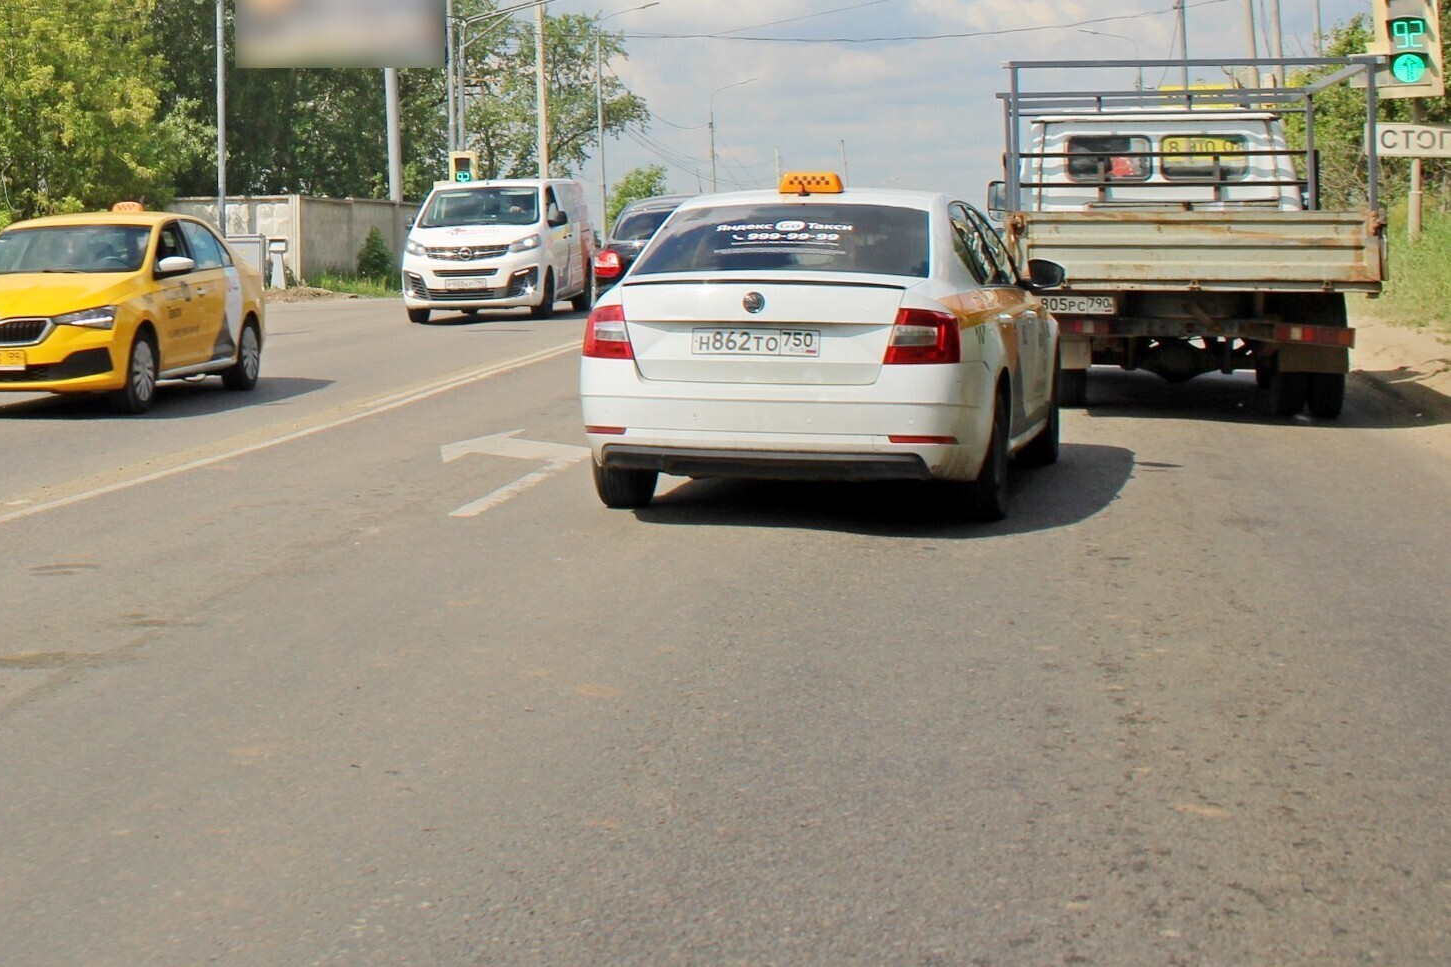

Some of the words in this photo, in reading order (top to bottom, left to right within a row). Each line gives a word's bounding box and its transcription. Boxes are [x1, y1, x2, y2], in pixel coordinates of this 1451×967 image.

[1392, 20, 1424, 48] 92
[716, 223, 774, 232] Яндекс
[807, 223, 853, 231] Такси
[747, 233, 840, 241] 999-99-99
[1088, 297, 1110, 308] 790
[699, 330, 778, 351] Н862ТО
[782, 331, 813, 348] 750
